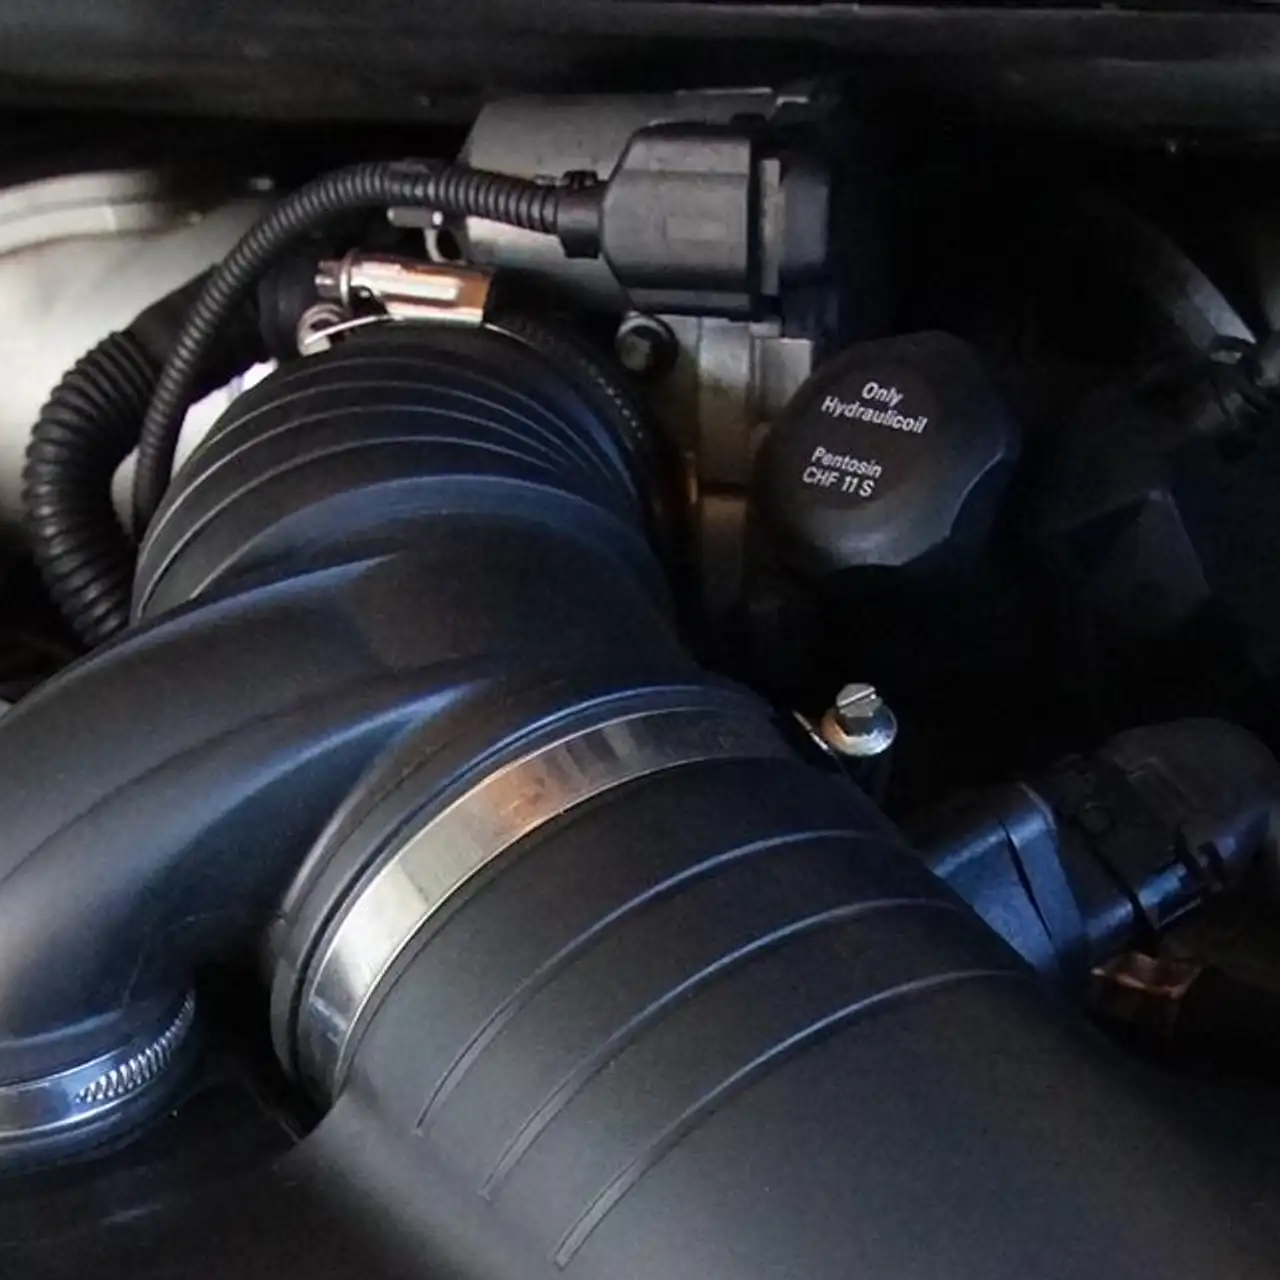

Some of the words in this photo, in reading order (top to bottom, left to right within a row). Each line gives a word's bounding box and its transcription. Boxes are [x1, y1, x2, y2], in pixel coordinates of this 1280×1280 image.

[862, 382, 904, 406] Only
[821, 396, 927, 433] Hydraulicoil
[812, 446, 883, 478] Pentosin
[802, 467, 839, 487] CHF
[841, 475, 856, 493] 11
[859, 481, 875, 498] S
